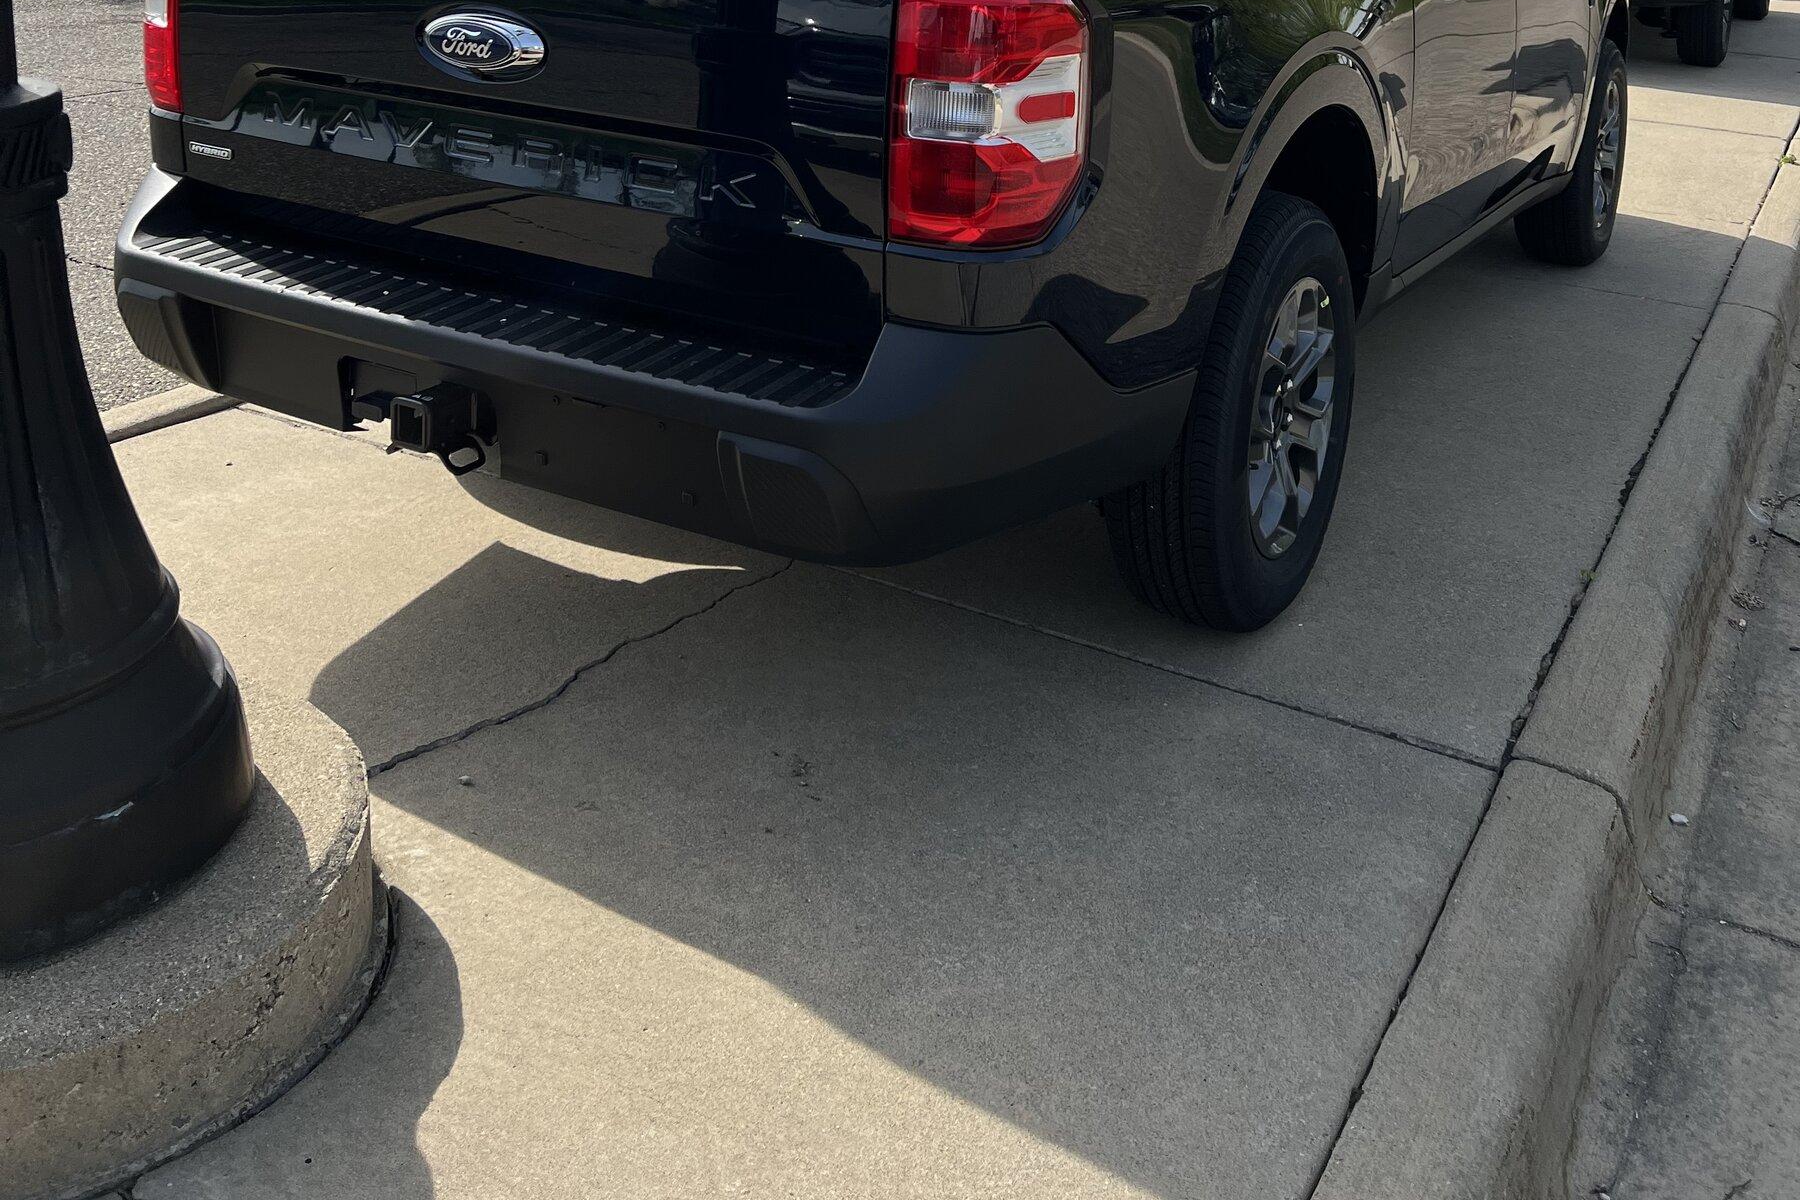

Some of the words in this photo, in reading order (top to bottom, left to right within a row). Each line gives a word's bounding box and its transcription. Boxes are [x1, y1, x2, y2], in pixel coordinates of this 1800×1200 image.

[441, 27, 494, 59] Ford
[191, 144, 229, 158] HYBRID
[262, 90, 757, 209] MAVERICK
